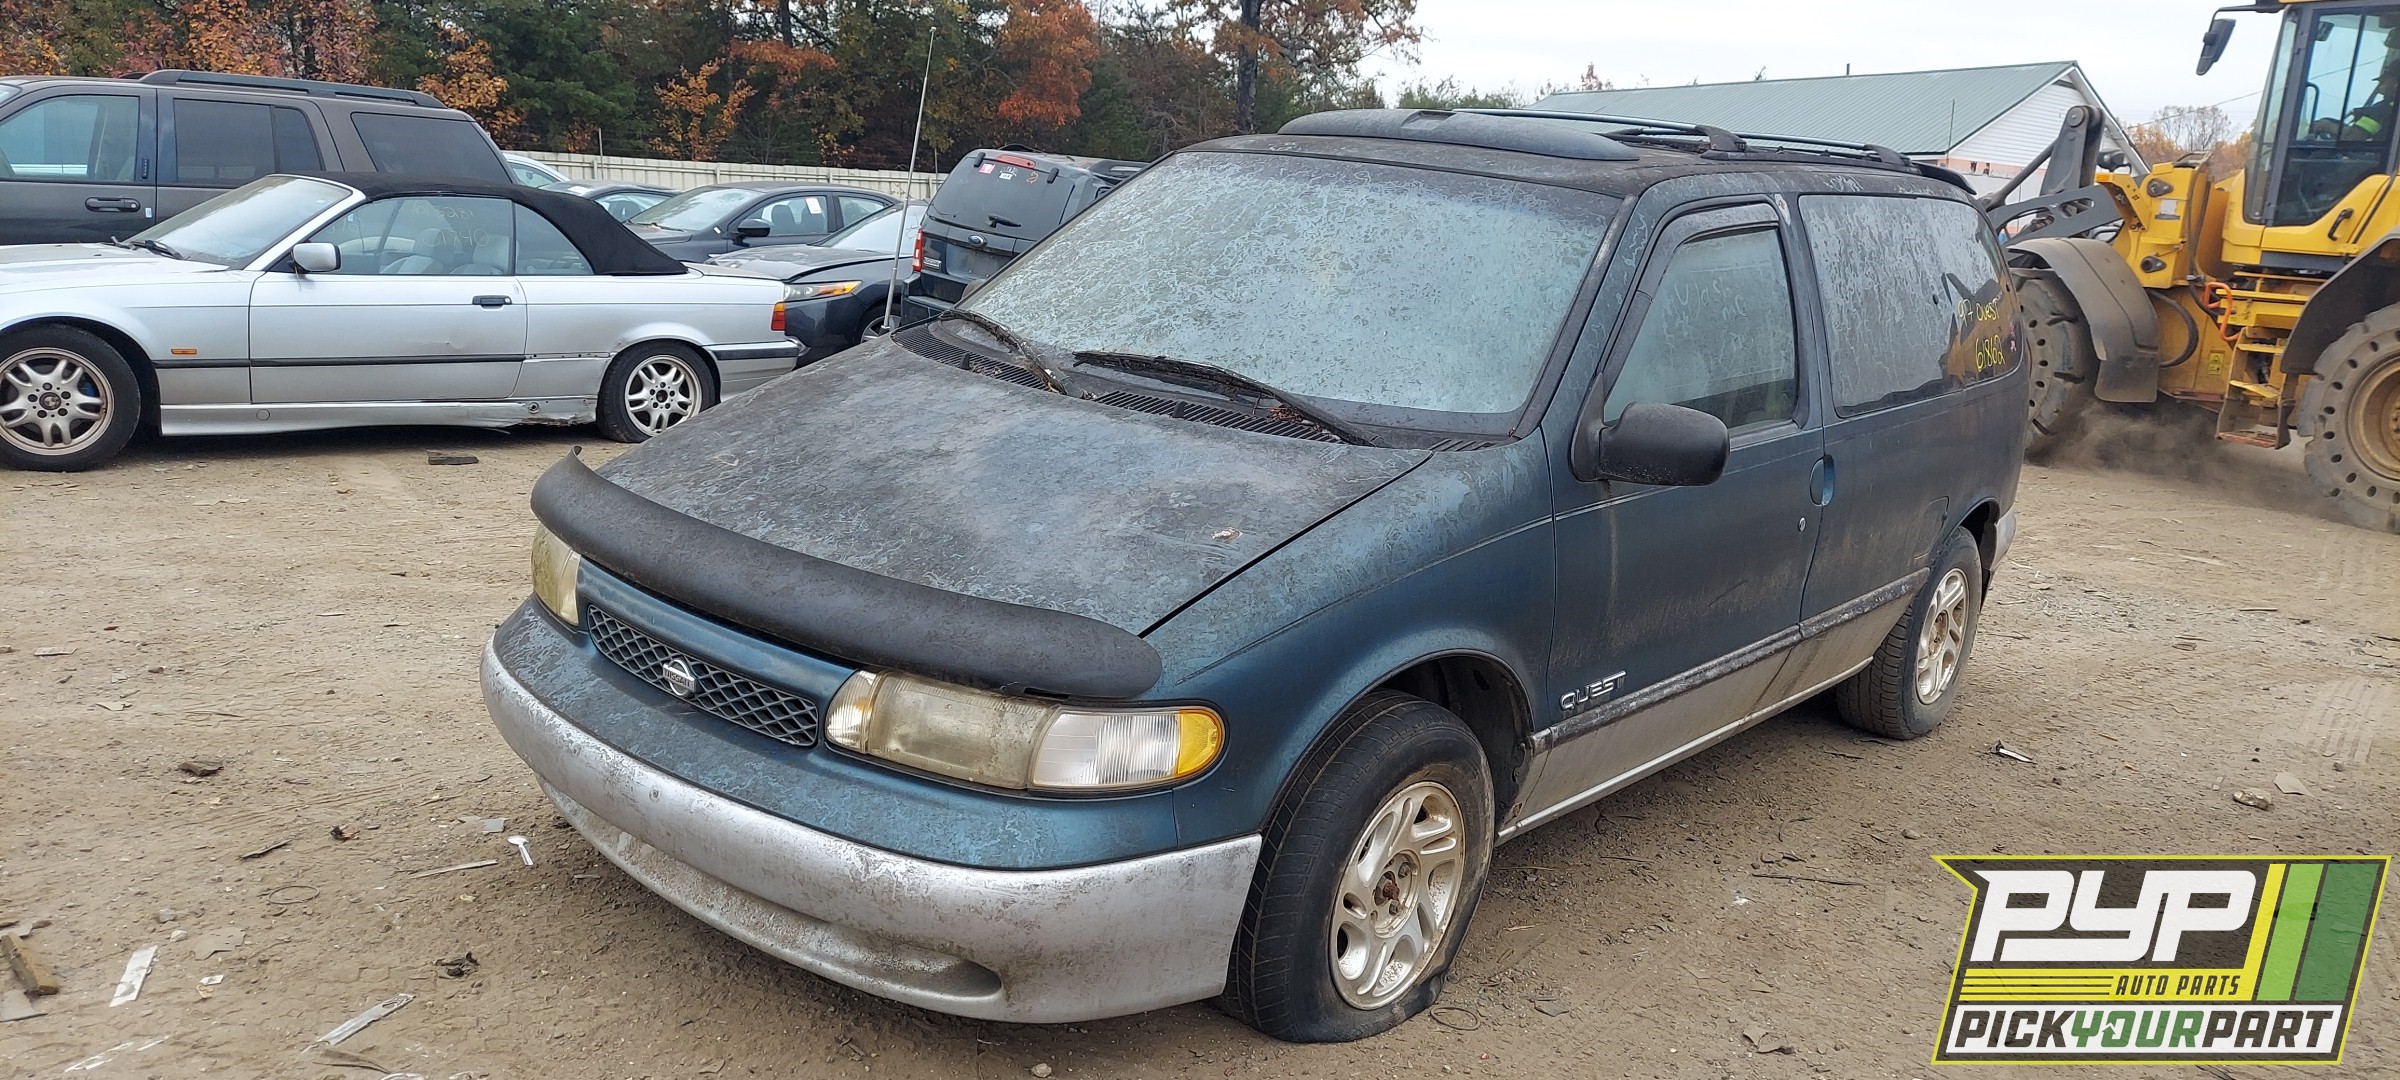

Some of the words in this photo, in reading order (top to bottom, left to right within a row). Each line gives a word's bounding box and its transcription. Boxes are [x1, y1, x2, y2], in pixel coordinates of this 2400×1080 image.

[1975, 334, 2006, 372] 61862
[664, 667, 693, 689] NISSAN
[1560, 670, 1627, 710] QUEST
